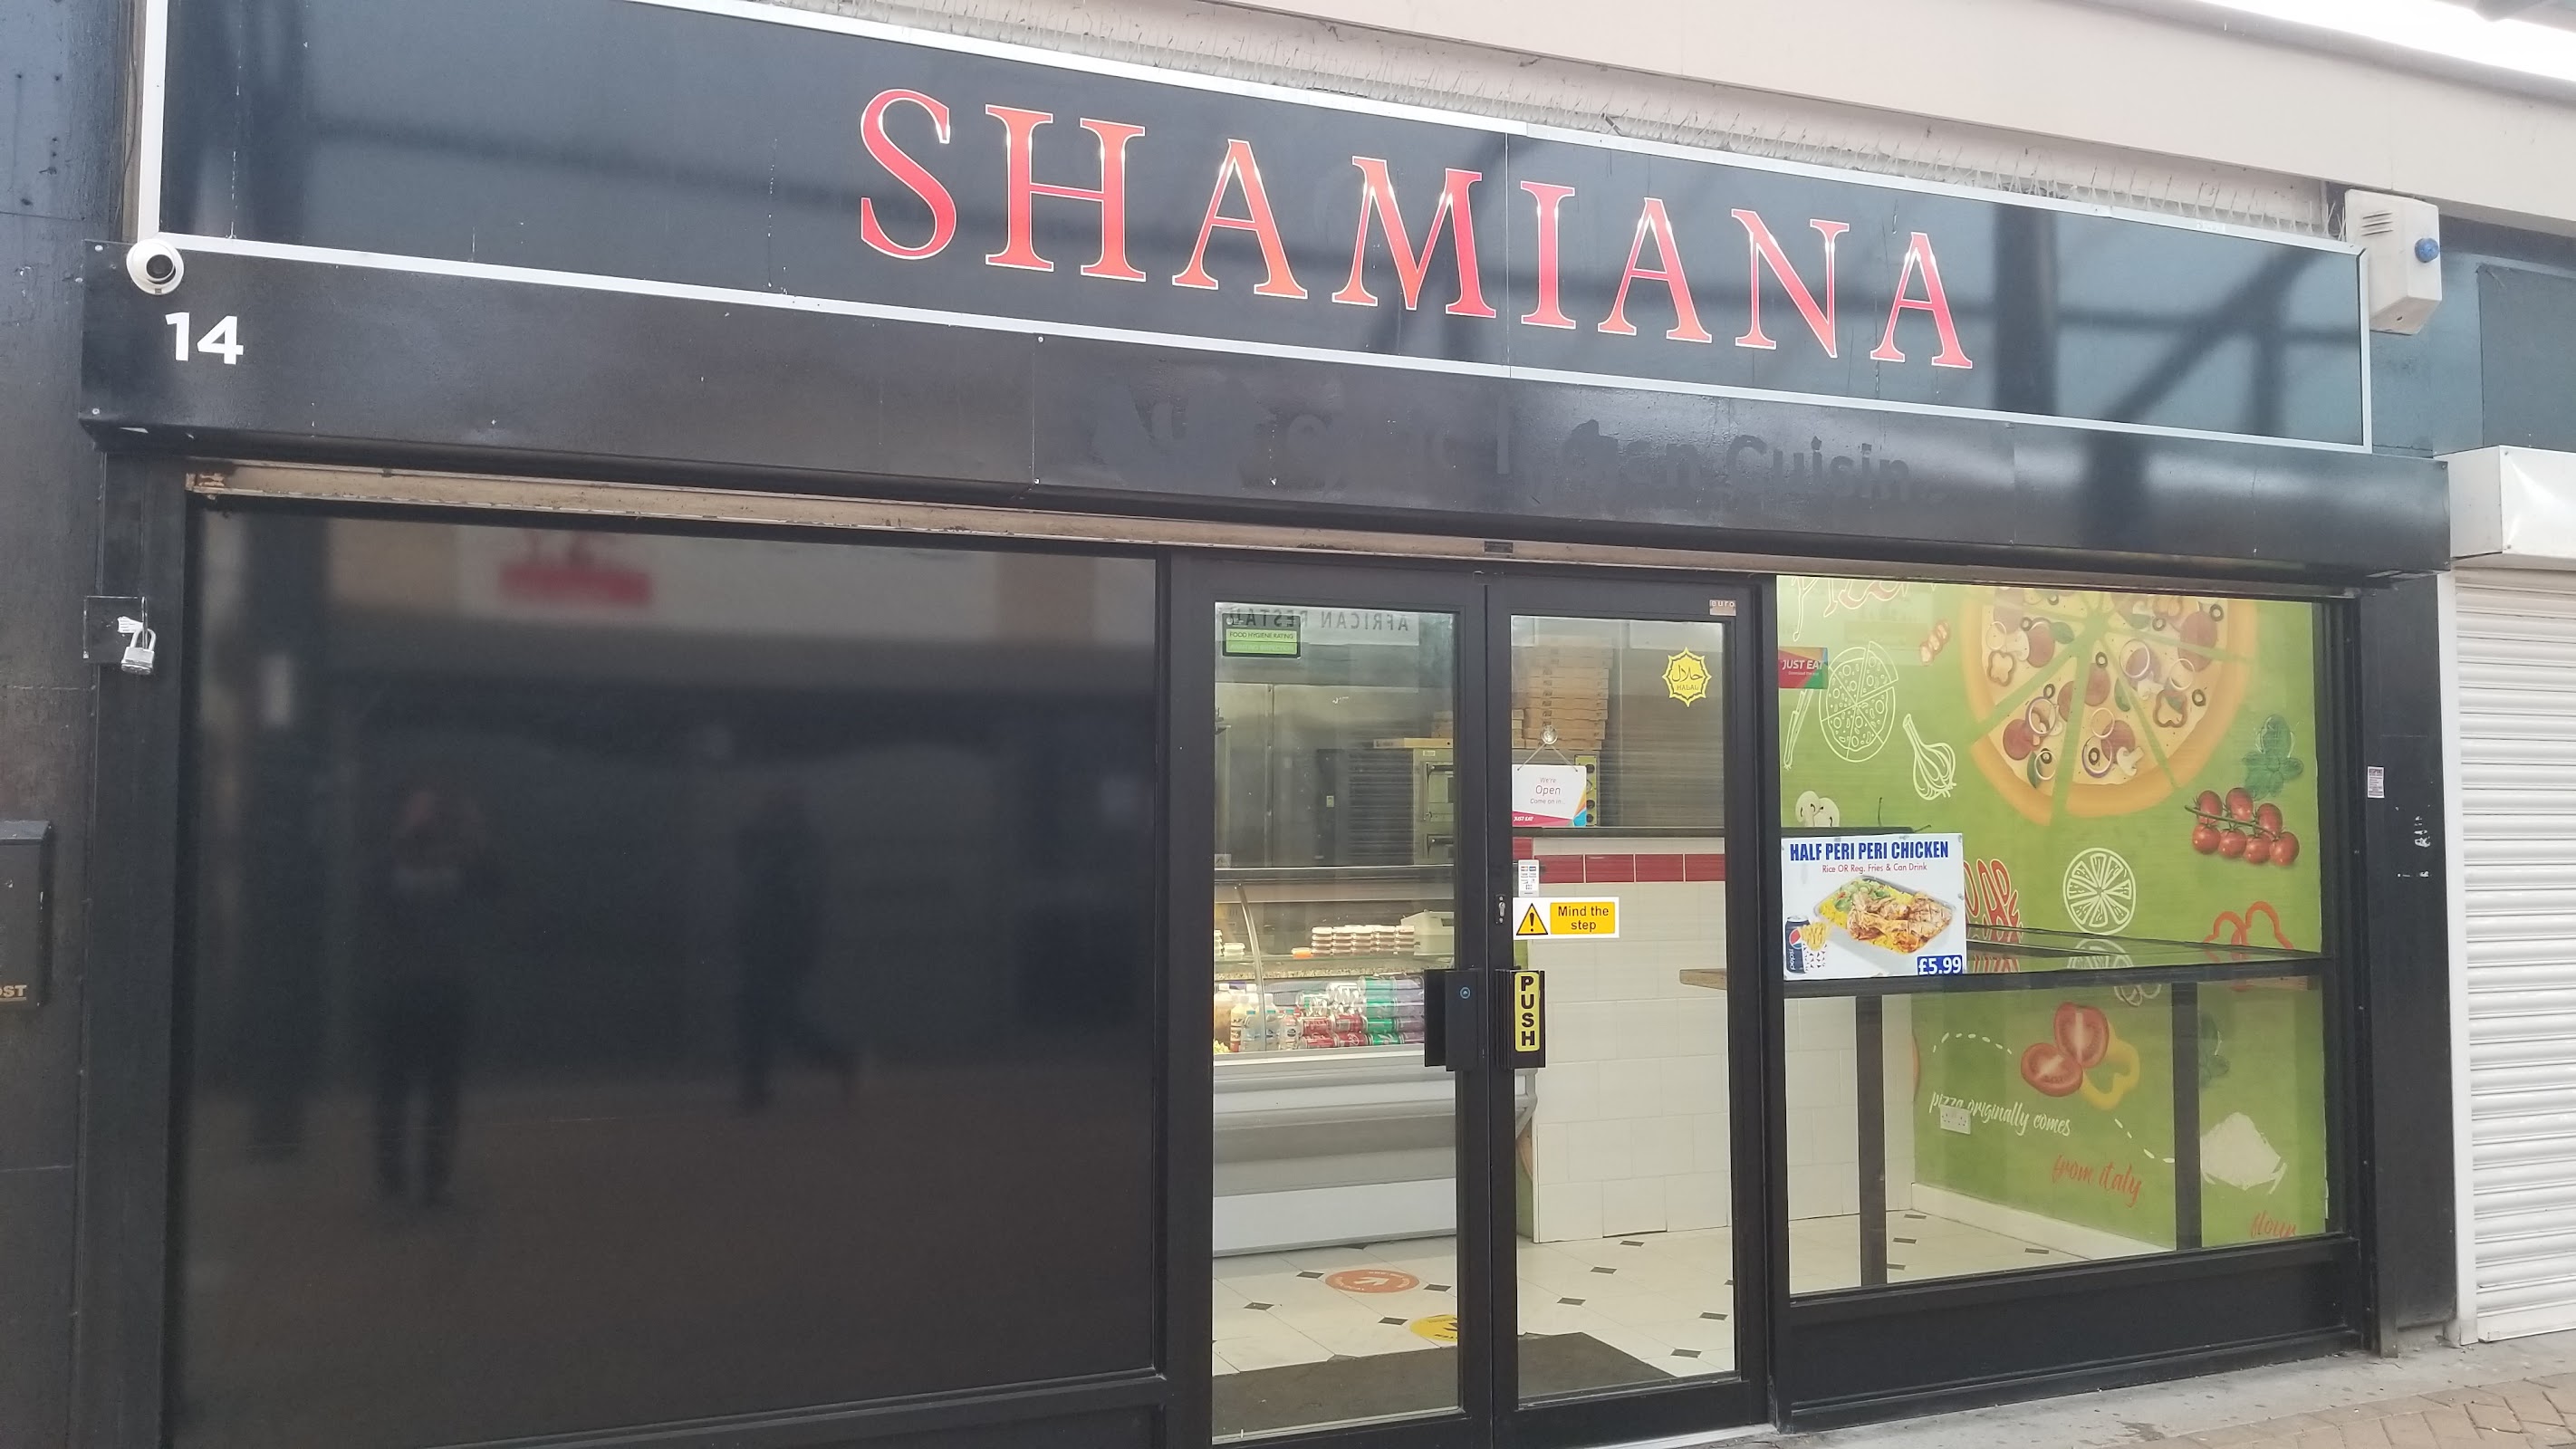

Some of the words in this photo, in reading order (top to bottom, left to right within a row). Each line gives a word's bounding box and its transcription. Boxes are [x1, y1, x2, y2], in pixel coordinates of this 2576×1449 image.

[860, 87, 1975, 369] SHAMIANA
[165, 312, 244, 365] 14
[1273, 632, 1294, 640] RATING
[1671, 664, 1704, 683] حلال
[1782, 659, 1805, 670] JUST
[1806, 659, 1822, 670] EAT
[1535, 784, 1561, 797] Open
[1790, 843, 1822, 861] HALF
[1825, 842, 1855, 860] PERI
[1858, 841, 1888, 859] PERI
[1891, 840, 1949, 859] CHICKEN
[1821, 864, 1836, 873] Rice
[1837, 864, 1849, 873] OR
[1850, 864, 1866, 874] Reg.
[1868, 863, 1884, 872] Fries
[1886, 863, 1891, 871] &
[1893, 863, 1908, 871] Can
[1908, 862, 1927, 871] Drink
[1558, 906, 1587, 916] Mind
[1591, 906, 1610, 916] the
[1571, 920, 1597, 932] step
[1918, 957, 1962, 975] £5.99
[0, 984, 27, 997] ST
[1521, 975, 1535, 1046] PUSH
[1928, 1091, 1965, 1114] pizza
[1966, 1099, 2031, 1137] originally
[2033, 1112, 2071, 1137] comes
[2052, 1154, 2094, 1185] from
[2099, 1161, 2142, 1208] italy
